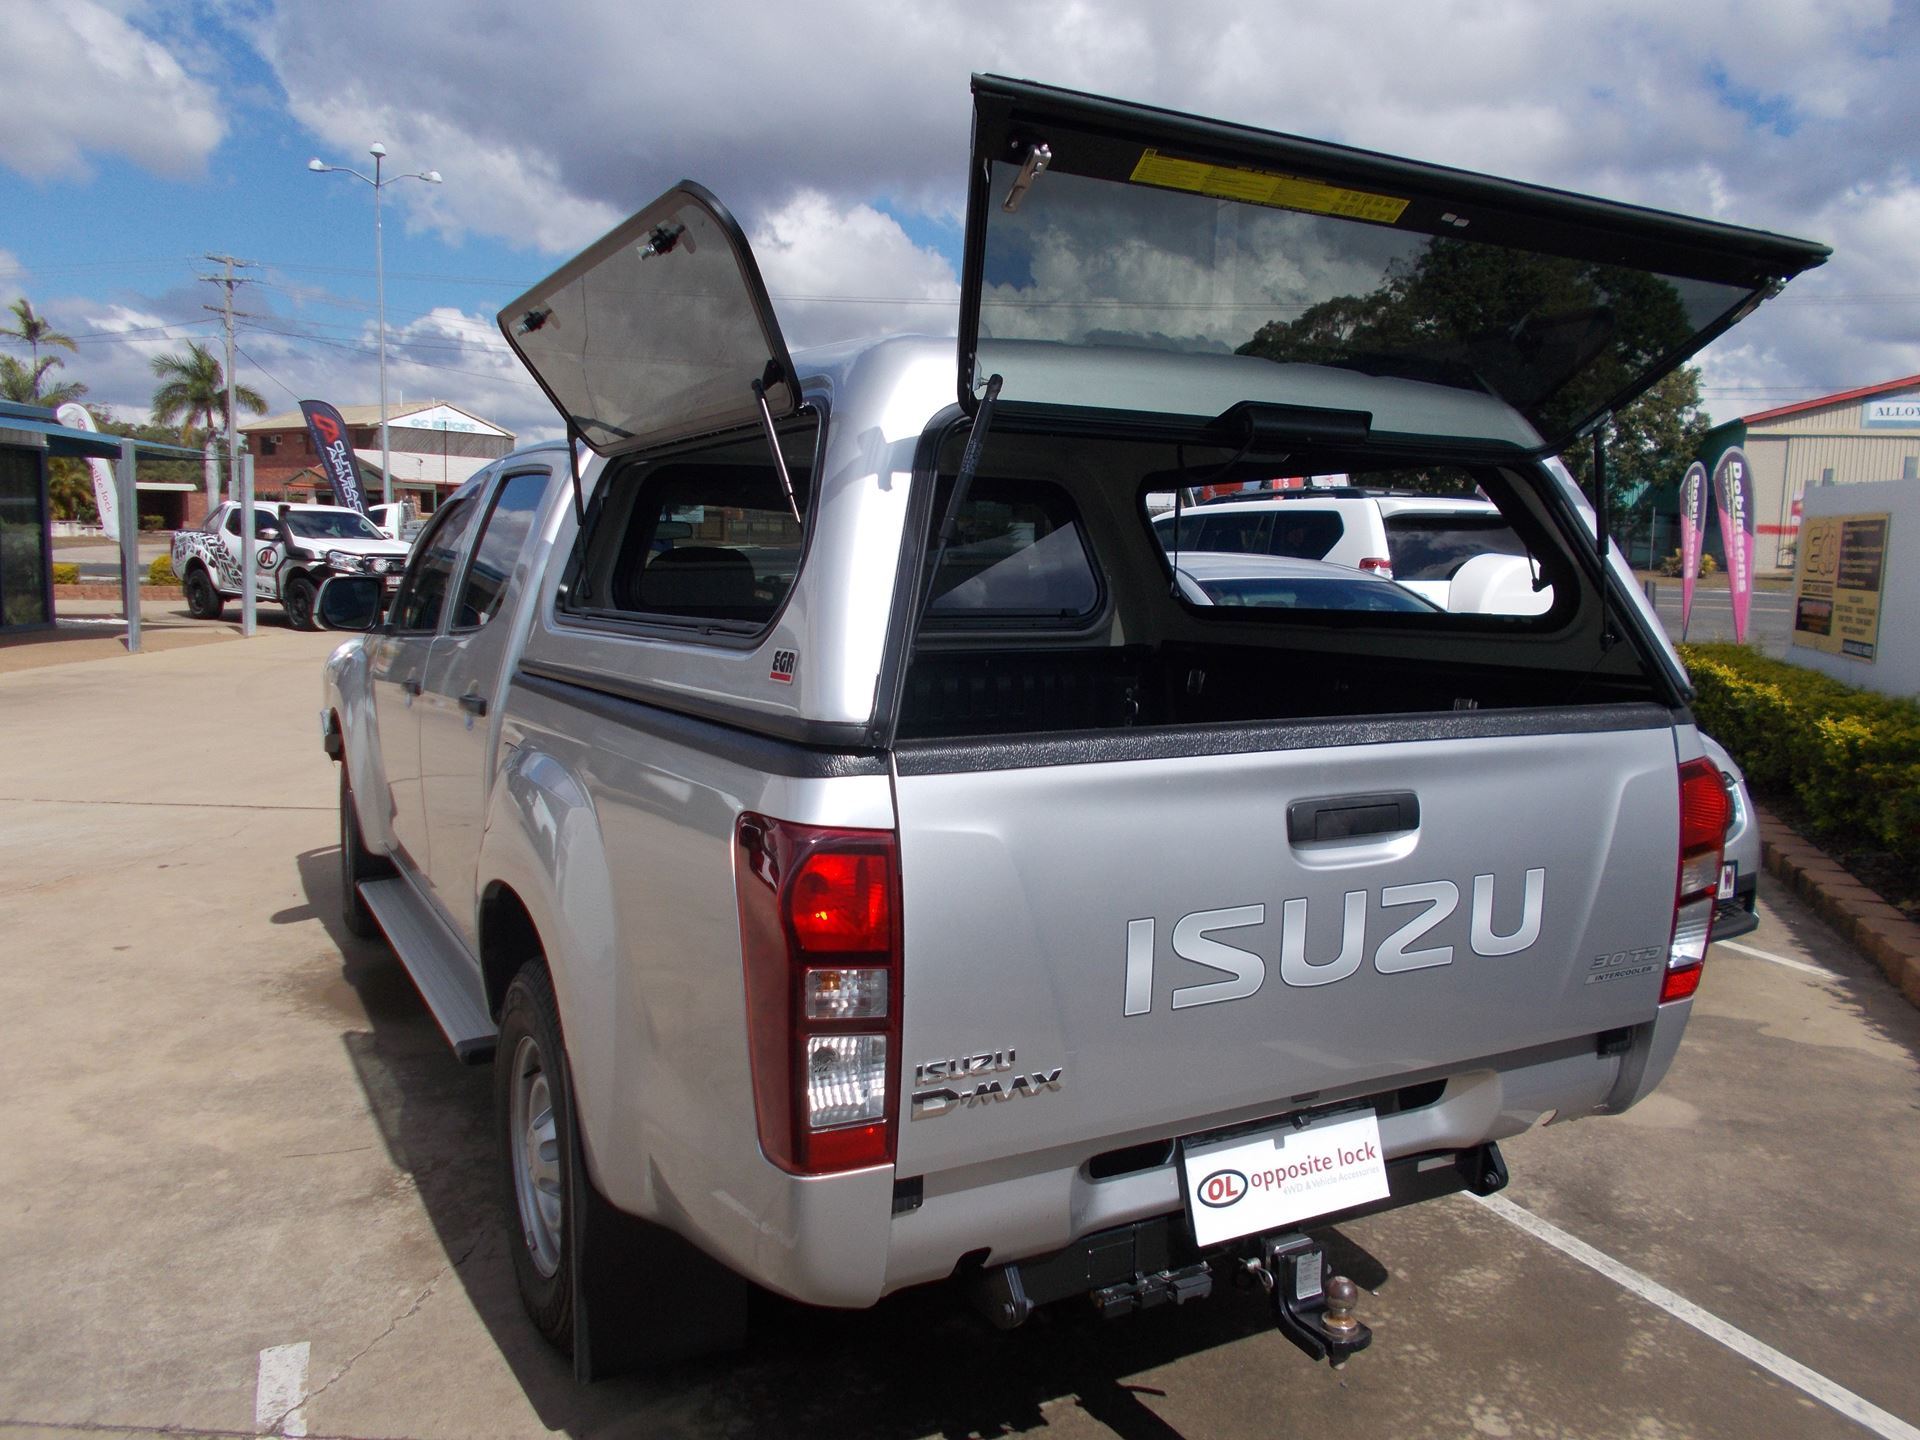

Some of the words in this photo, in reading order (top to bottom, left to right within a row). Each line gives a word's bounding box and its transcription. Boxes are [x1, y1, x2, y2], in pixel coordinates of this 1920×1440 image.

[326, 446, 359, 512] ARMOU
[334, 440, 365, 516] OUTBAC
[1732, 461, 1746, 593] Dobinsons
[772, 650, 796, 674] EGR
[1123, 866, 1546, 1017] ISUZU
[1594, 966, 1653, 981] INTERCOOLER
[910, 1067, 1063, 1122] D-MAX
[915, 1048, 1016, 1086] ISUZU
[1207, 1176, 1239, 1201] OL
[1250, 1155, 1333, 1191] opposite
[1337, 1141, 1377, 1167] lock
[1338, 1165, 1381, 1184] Accessories
